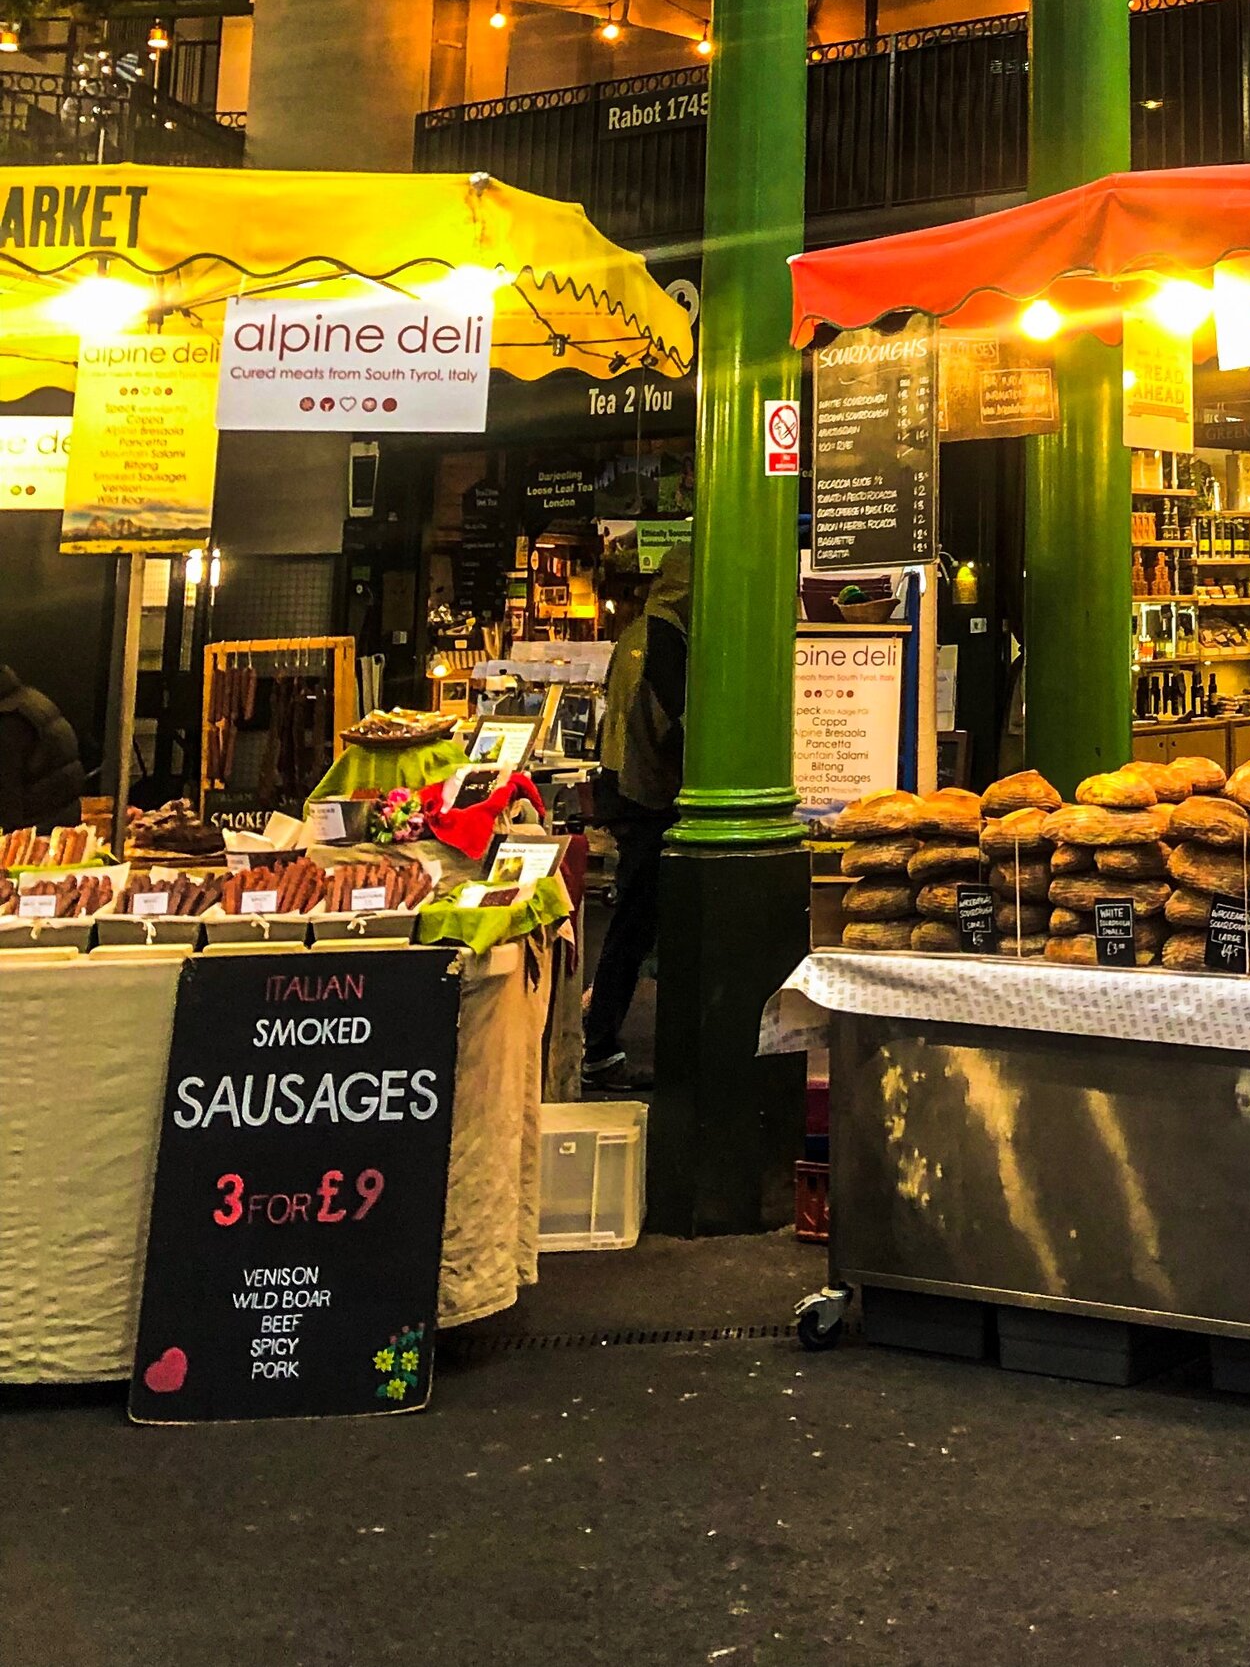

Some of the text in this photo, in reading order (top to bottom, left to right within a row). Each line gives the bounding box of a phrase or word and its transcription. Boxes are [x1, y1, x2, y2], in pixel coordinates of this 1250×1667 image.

[608, 92, 710, 130] Rabot 1745
[233, 313, 484, 361] alpine deli
[83, 342, 221, 367] alpine deli
[819, 338, 928, 369] SOURDOUGHS
[230, 366, 276, 380] Cured
[280, 368, 324, 380] meats
[328, 367, 361, 380] from
[365, 368, 405, 381] South
[448, 369, 477, 383] Italy
[588, 384, 673, 415] Tea 2 You
[538, 470, 583, 482] Darjeeling
[527, 483, 593, 496] Loose Leaf Tea
[543, 498, 576, 509] London
[852, 645, 897, 667] deli
[812, 717, 847, 727] Coppa
[825, 728, 866, 737] Bresaola
[805, 739, 851, 749] Pancetta
[836, 750, 869, 760] Salami
[811, 761, 844, 773] Biltong
[825, 772, 871, 785] Sausages
[810, 795, 833, 805] Boar
[1100, 907, 1124, 918] WHITE
[1102, 927, 1125, 935] SMALL
[1218, 933, 1242, 943] LARGE
[265, 973, 365, 1002] ITALIAN
[253, 1016, 371, 1048] SMOKED
[173, 1068, 439, 1130] SAUSAGES
[212, 1168, 385, 1227] 3 FOR £9
[243, 1266, 319, 1287] VENISON
[232, 1289, 331, 1309] WILD BOAR
[260, 1313, 303, 1333] BEEF
[250, 1337, 299, 1357] SPICY
[251, 1360, 299, 1381] PORK
